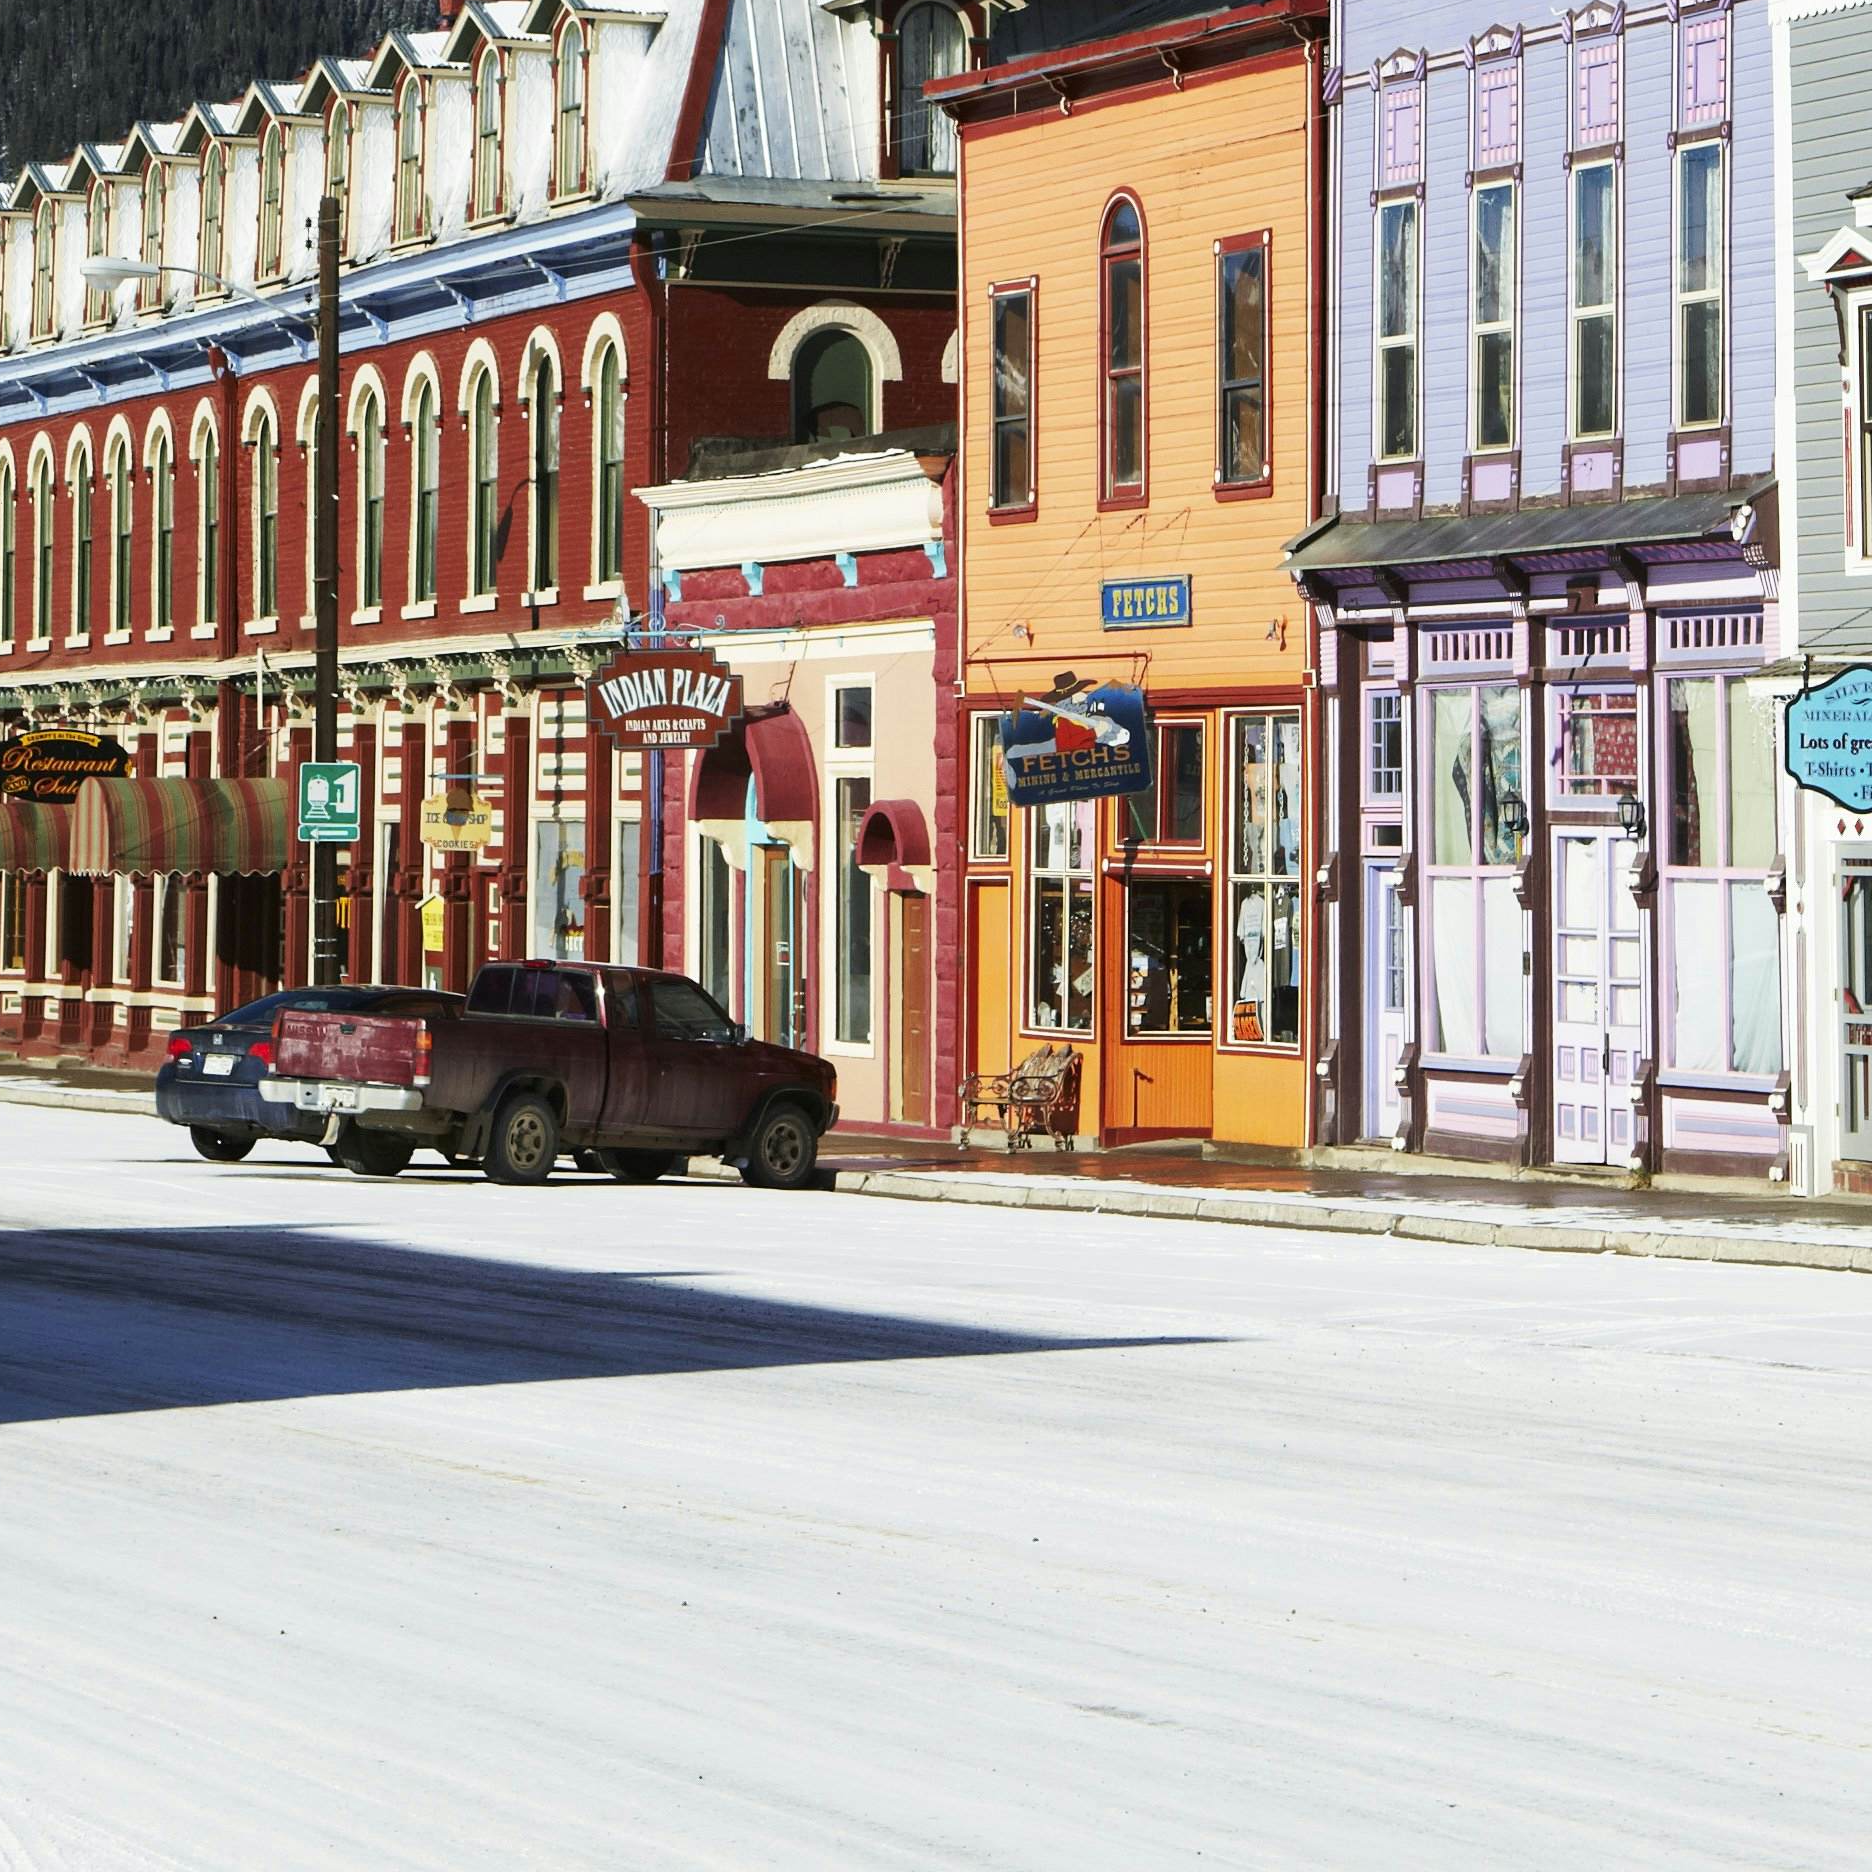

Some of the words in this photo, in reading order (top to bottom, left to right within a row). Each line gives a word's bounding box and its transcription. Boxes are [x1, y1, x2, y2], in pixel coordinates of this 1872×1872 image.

[1112, 585, 1179, 618] FETCHS
[598, 668, 667, 719] INDIAN
[671, 668, 731, 718] PLAZA
[625, 719, 651, 731] INDIAN
[652, 719, 670, 731] ARTS
[679, 718, 706, 731] CRAFTS
[643, 732, 657, 744] AND
[659, 731, 691, 744] JEWELRY
[1800, 732, 1828, 750] Lots
[1833, 732, 1849, 750] of
[1, 745, 118, 772] Restaurant
[1017, 772, 1057, 789] MINING
[1062, 771, 1070, 783] &
[1075, 762, 1141, 782] MERCANTILE
[1806, 761, 1856, 777] T-Shirts
[425, 812, 440, 824] ICE
[466, 812, 488, 825] SHOP
[438, 839, 475, 849] COOKIES
